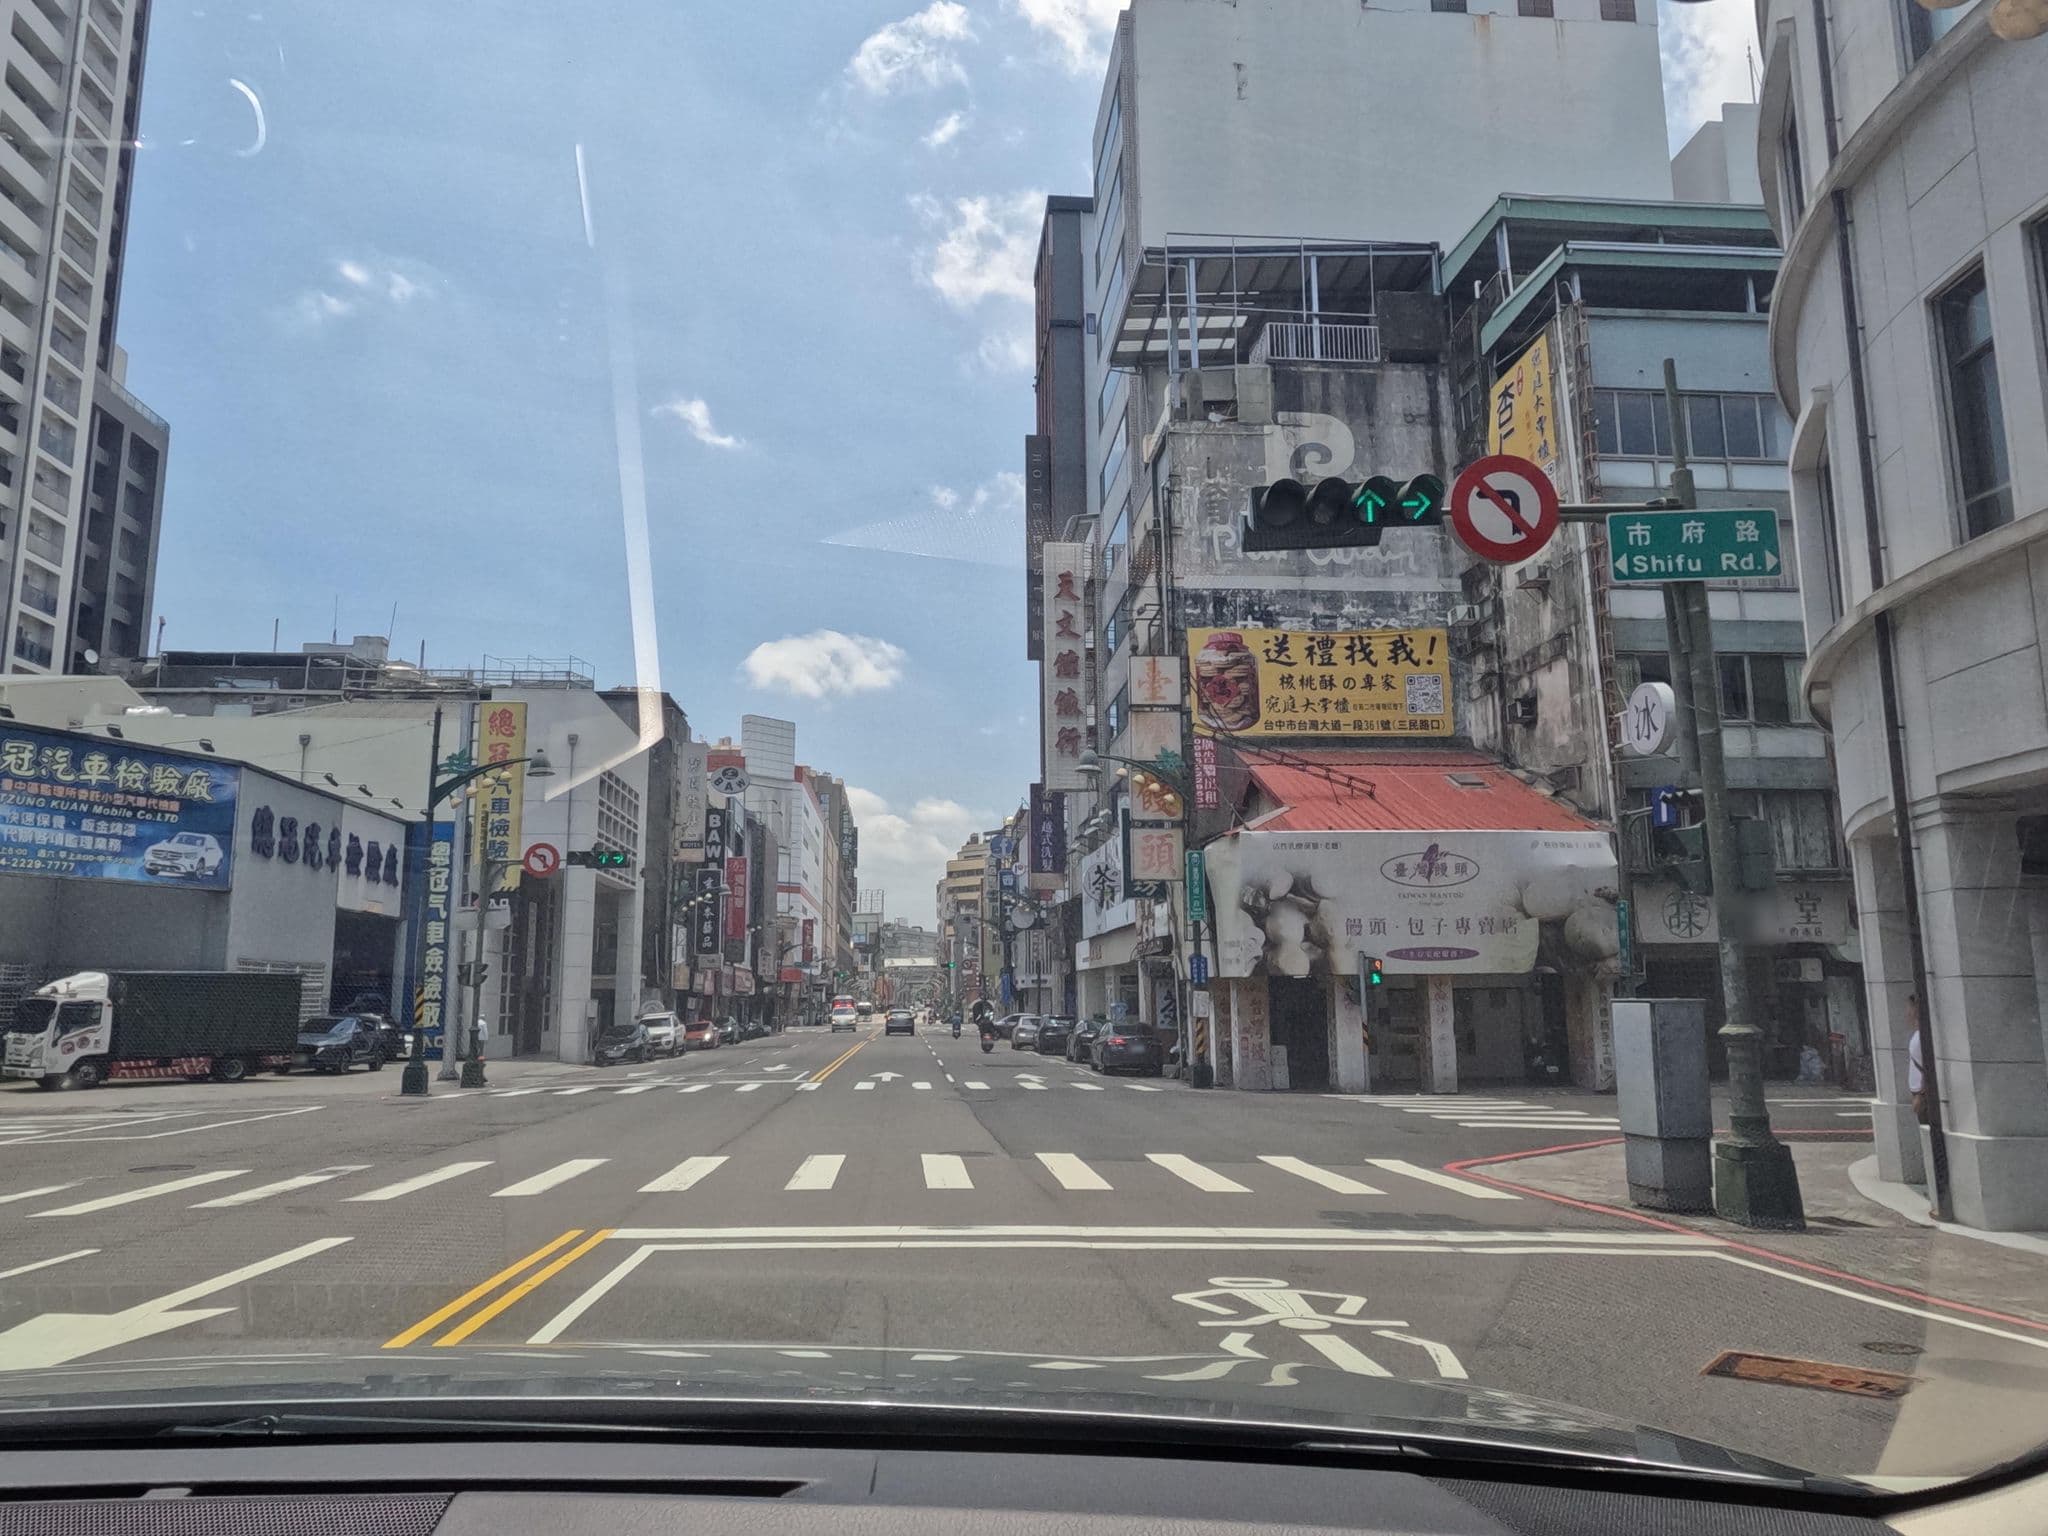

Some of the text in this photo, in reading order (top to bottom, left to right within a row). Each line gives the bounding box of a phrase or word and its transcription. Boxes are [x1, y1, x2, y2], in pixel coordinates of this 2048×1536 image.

[1626, 520, 1759, 546] 市府路
[1633, 552, 1762, 574] Shifu Rd.
[1263, 633, 1437, 667] 送禮找我!
[1279, 674, 1398, 691] 核桃酥の專家
[1634, 696, 1659, 742] 冰
[1, 740, 216, 802] 冠汽車檢驗廠
[714, 776, 747, 791] BAW
[50, 799, 89, 812] KUAN
[92, 805, 133, 818] Mobile
[137, 809, 180, 823] Co.LTD
[706, 814, 722, 858] BAW
